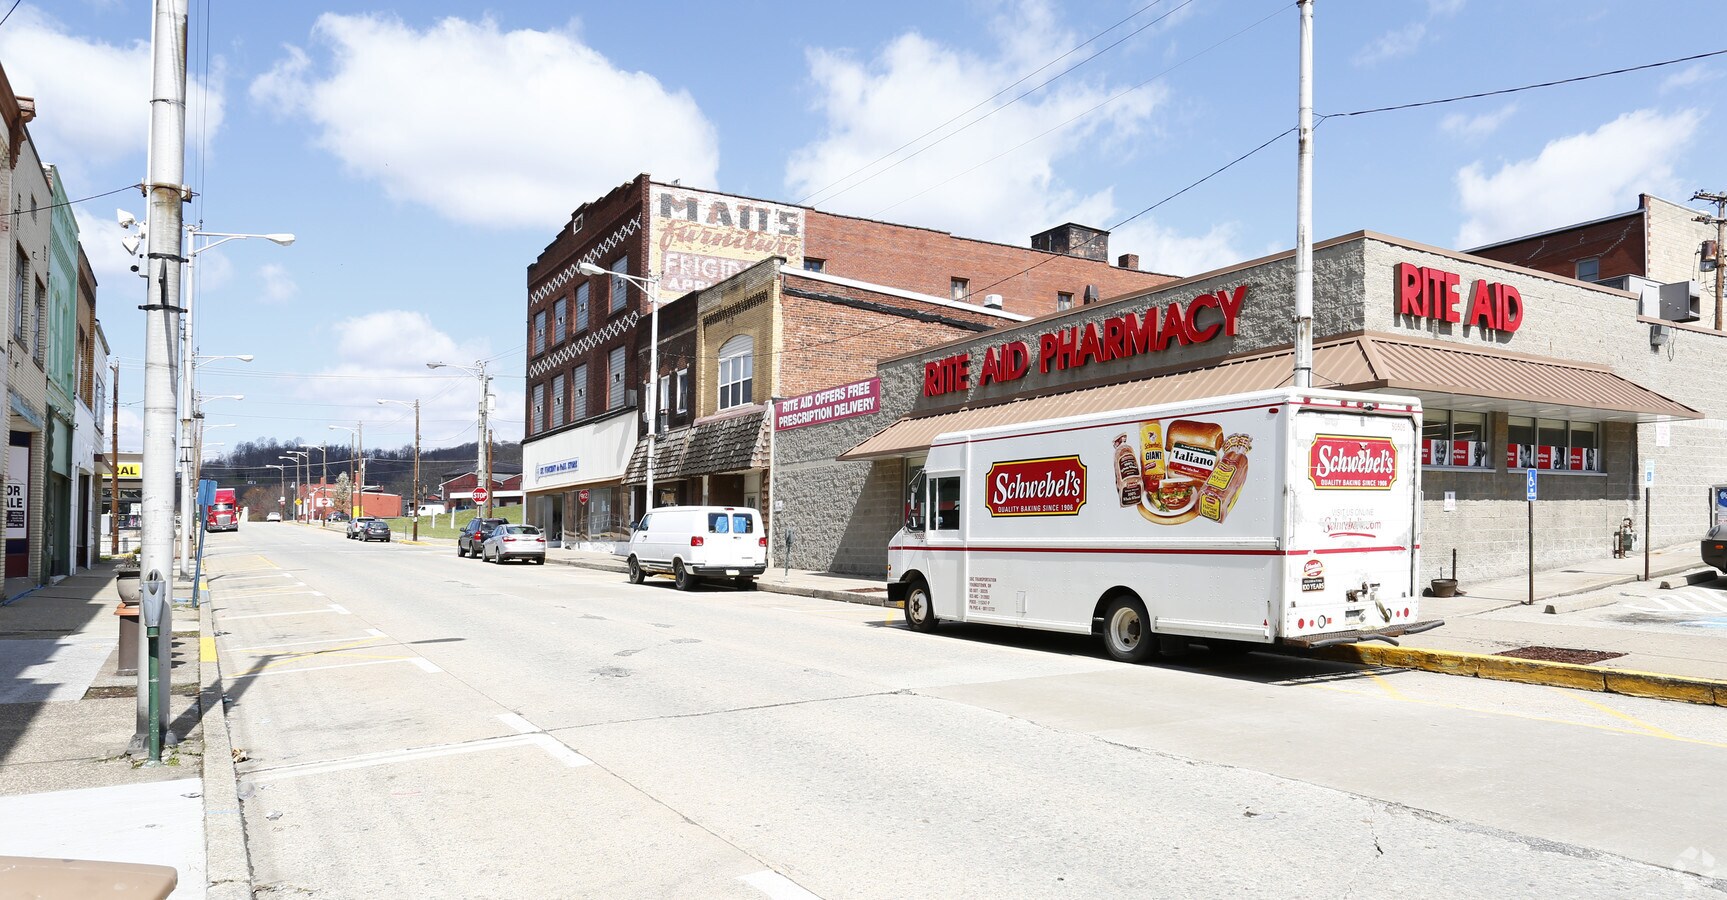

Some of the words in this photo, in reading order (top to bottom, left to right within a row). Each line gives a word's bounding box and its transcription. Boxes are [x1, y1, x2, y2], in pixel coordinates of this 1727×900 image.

[666, 253, 752, 279] FRIGID
[1394, 262, 1460, 323] RITE
[1463, 279, 1524, 332] AID
[924, 353, 970, 397] RITE
[979, 340, 1031, 386] AID
[1039, 285, 1249, 374] PHARMACY
[778, 408, 832, 428] PRESCRIPTION
[834, 397, 876, 416] DELIVERY
[782, 399, 798, 413] RITE
[800, 396, 812, 409] AID
[814, 387, 846, 406] OFFERS
[848, 382, 870, 398] FREE
[1146, 451, 1162, 460] GIANT
[1316, 444, 1393, 478] Schwebel's
[7, 485, 20, 496] OR
[992, 469, 1081, 504] Schwebel's
